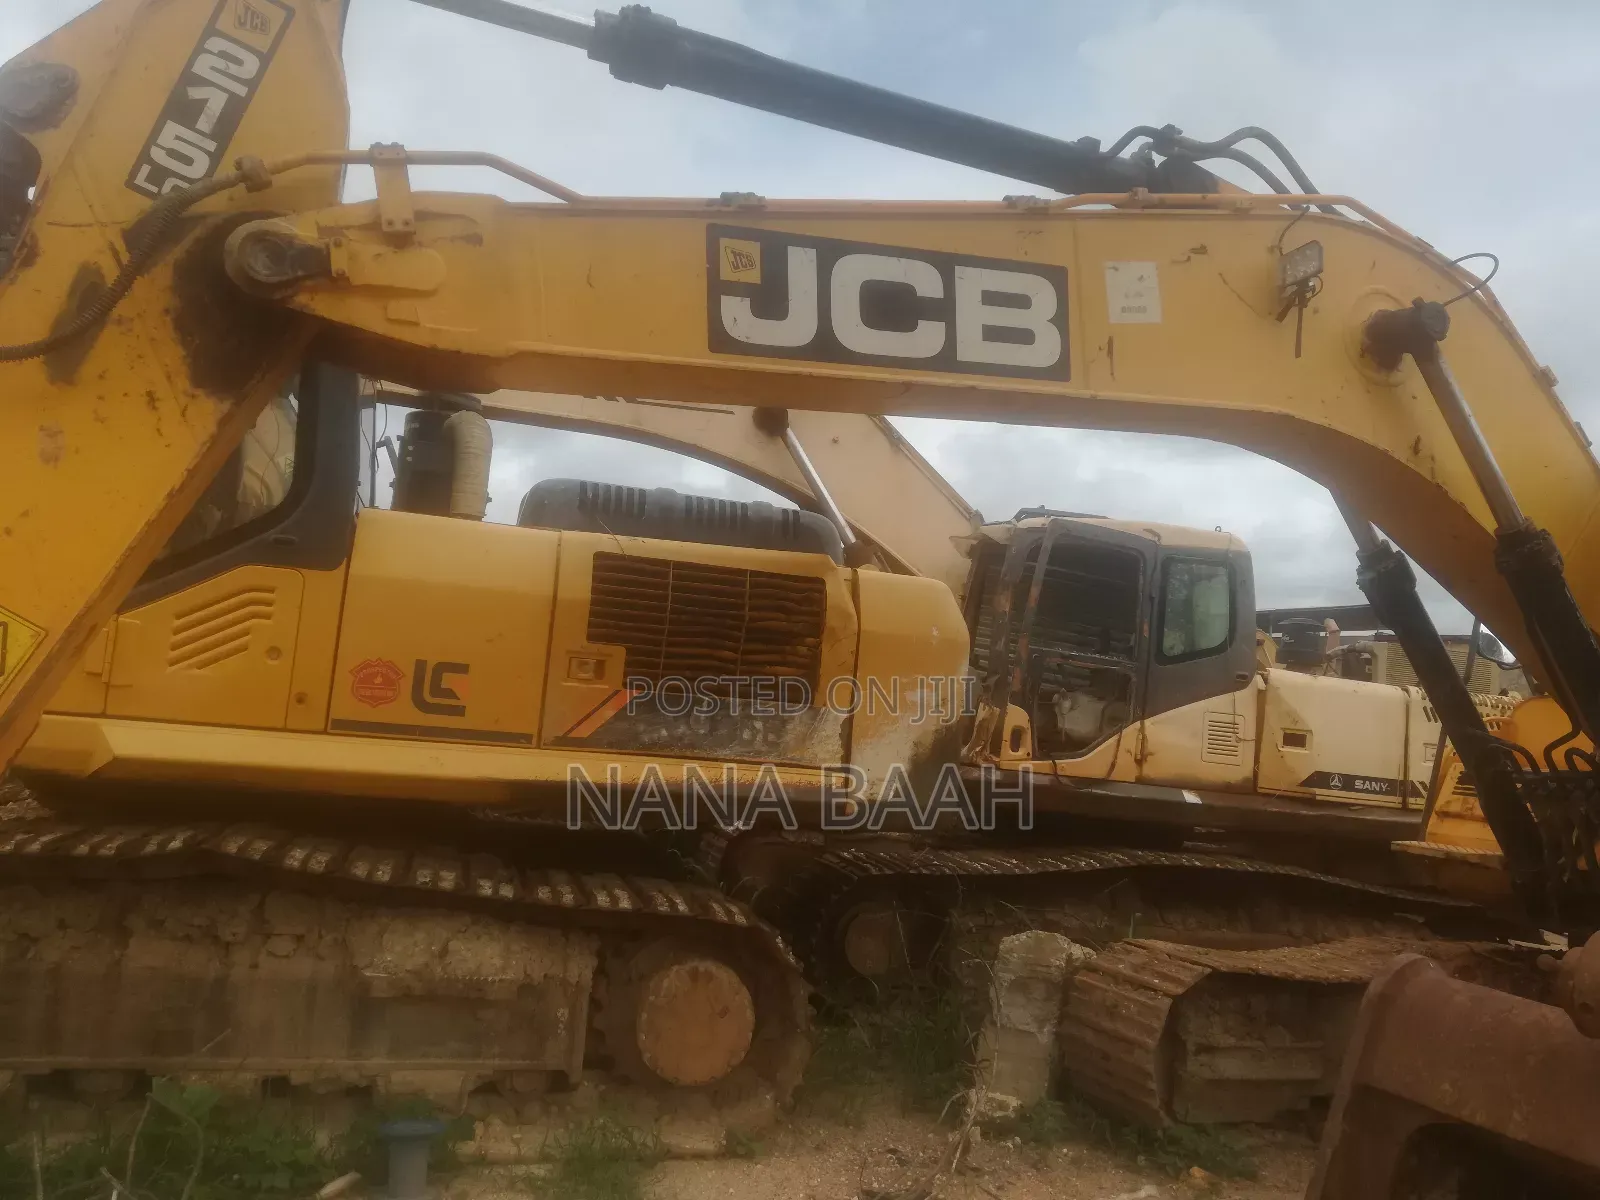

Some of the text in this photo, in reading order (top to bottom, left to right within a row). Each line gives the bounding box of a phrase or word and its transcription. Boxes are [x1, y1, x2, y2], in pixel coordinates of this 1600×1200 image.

[237, 1, 269, 33] JCB
[730, 249, 755, 271] JCB
[720, 245, 1062, 368] JCB
[1354, 779, 1389, 792] SANY
